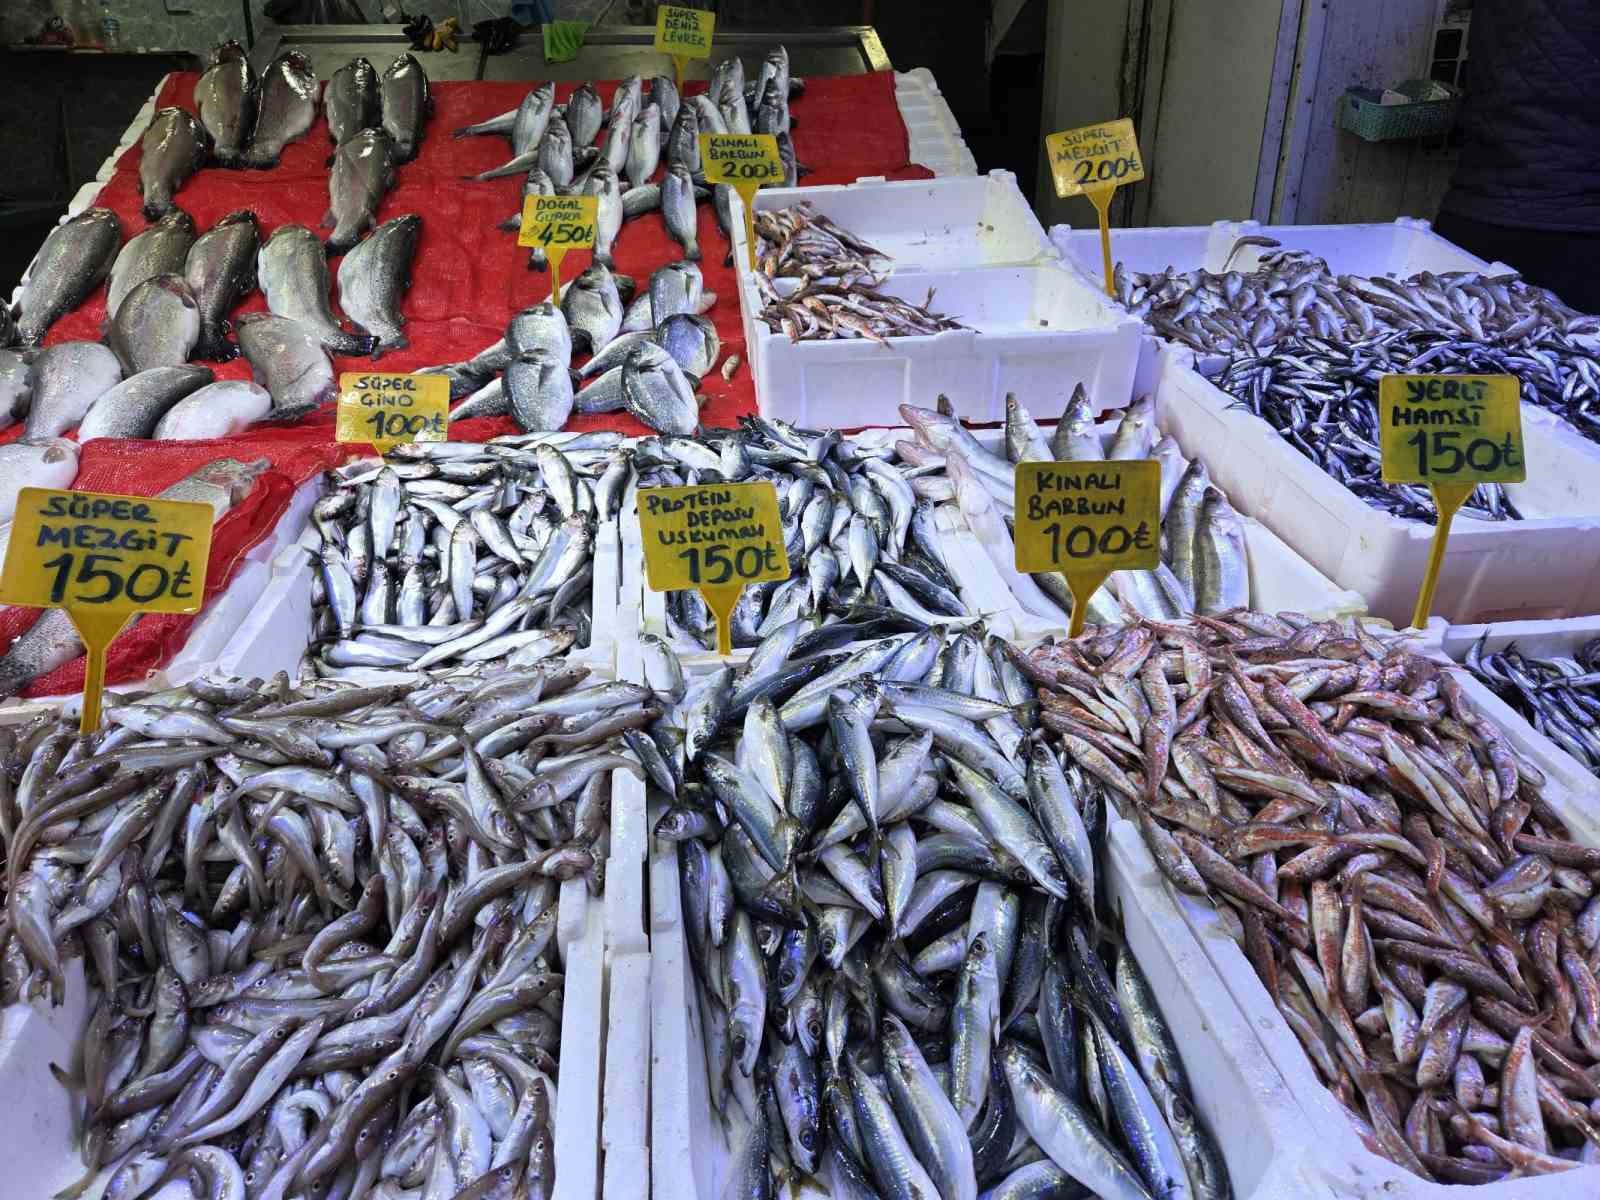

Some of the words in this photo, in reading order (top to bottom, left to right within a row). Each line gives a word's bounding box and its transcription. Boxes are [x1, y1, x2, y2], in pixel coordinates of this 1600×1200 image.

[710, 137, 758, 148] KINALI
[710, 148, 764, 160] BARBUN
[1037, 471, 1121, 492] KINALI
[39, 493, 158, 523] SÜPER
[1028, 494, 1126, 520] BARBUN
[37, 524, 193, 557] MEZGİT
